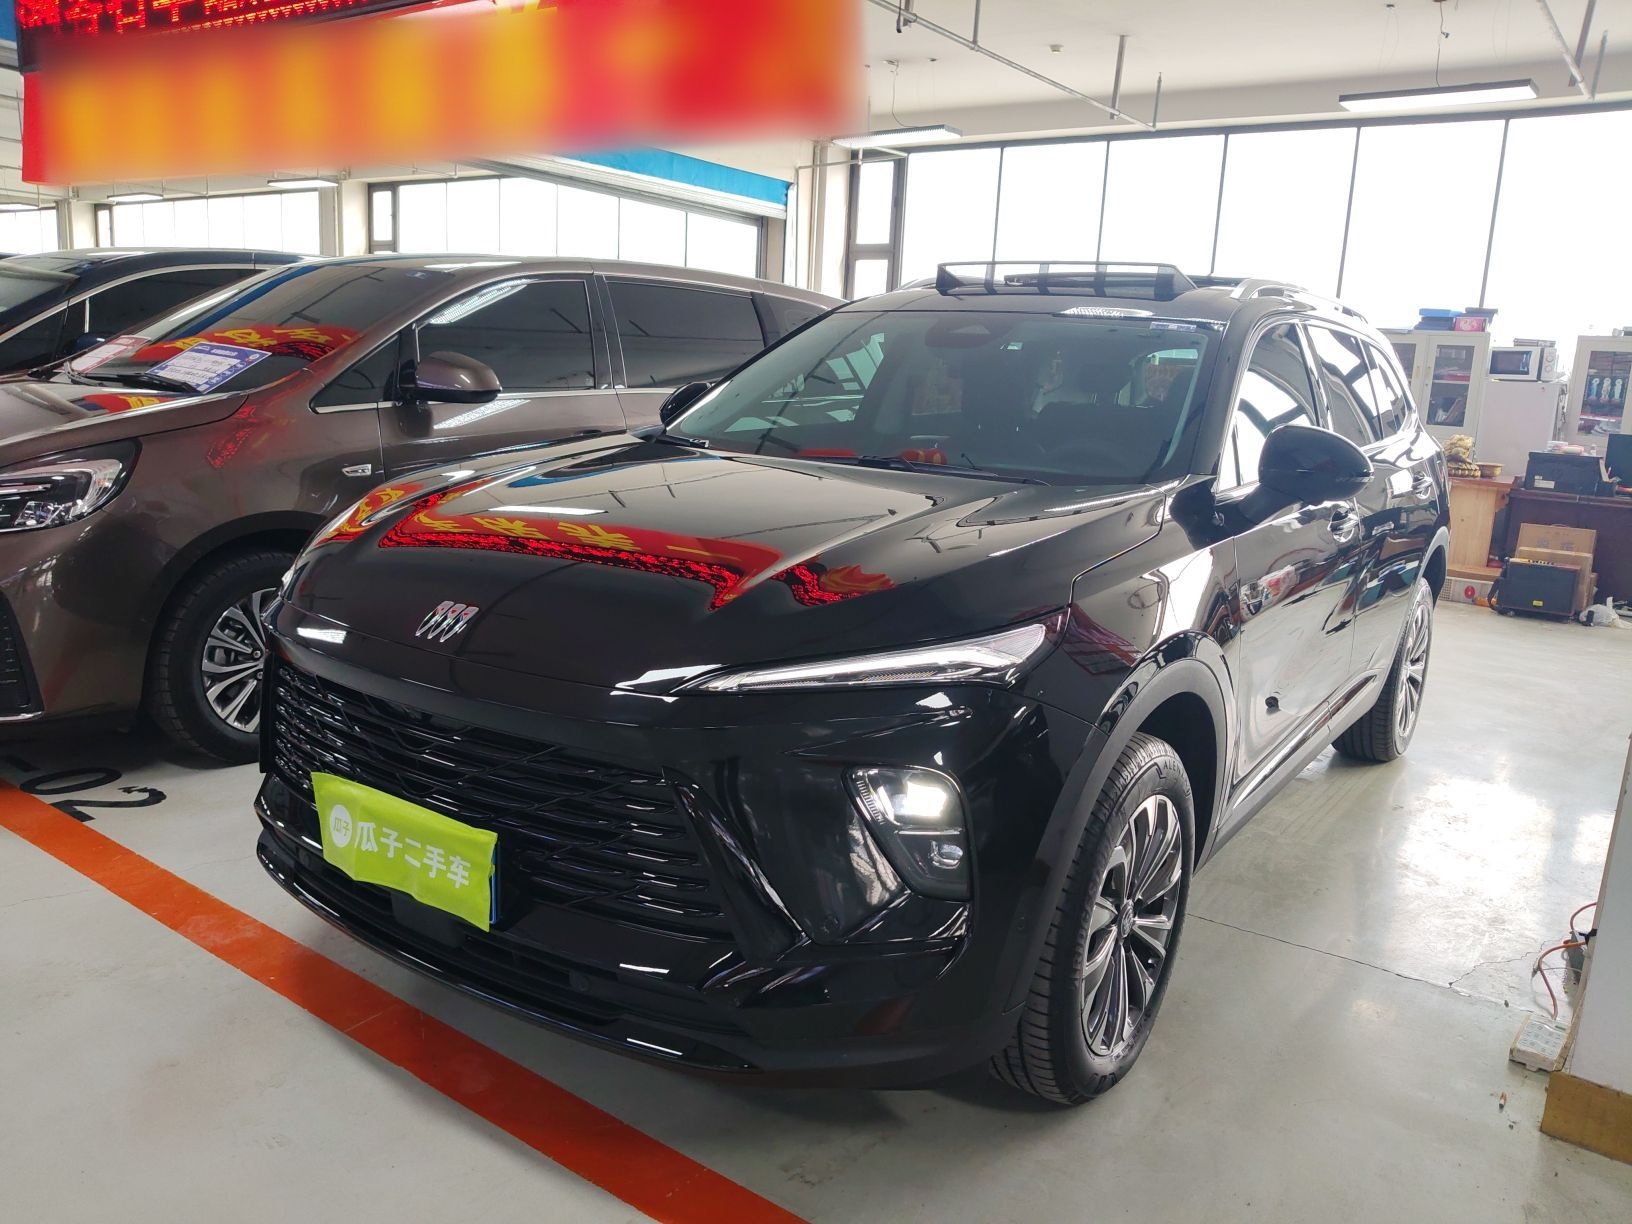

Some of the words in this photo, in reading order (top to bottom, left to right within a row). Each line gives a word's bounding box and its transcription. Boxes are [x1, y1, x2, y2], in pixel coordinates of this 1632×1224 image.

[5, 755, 167, 822] 02
[333, 815, 350, 838] 瓜子
[354, 821, 472, 889] 瓜子二手车
